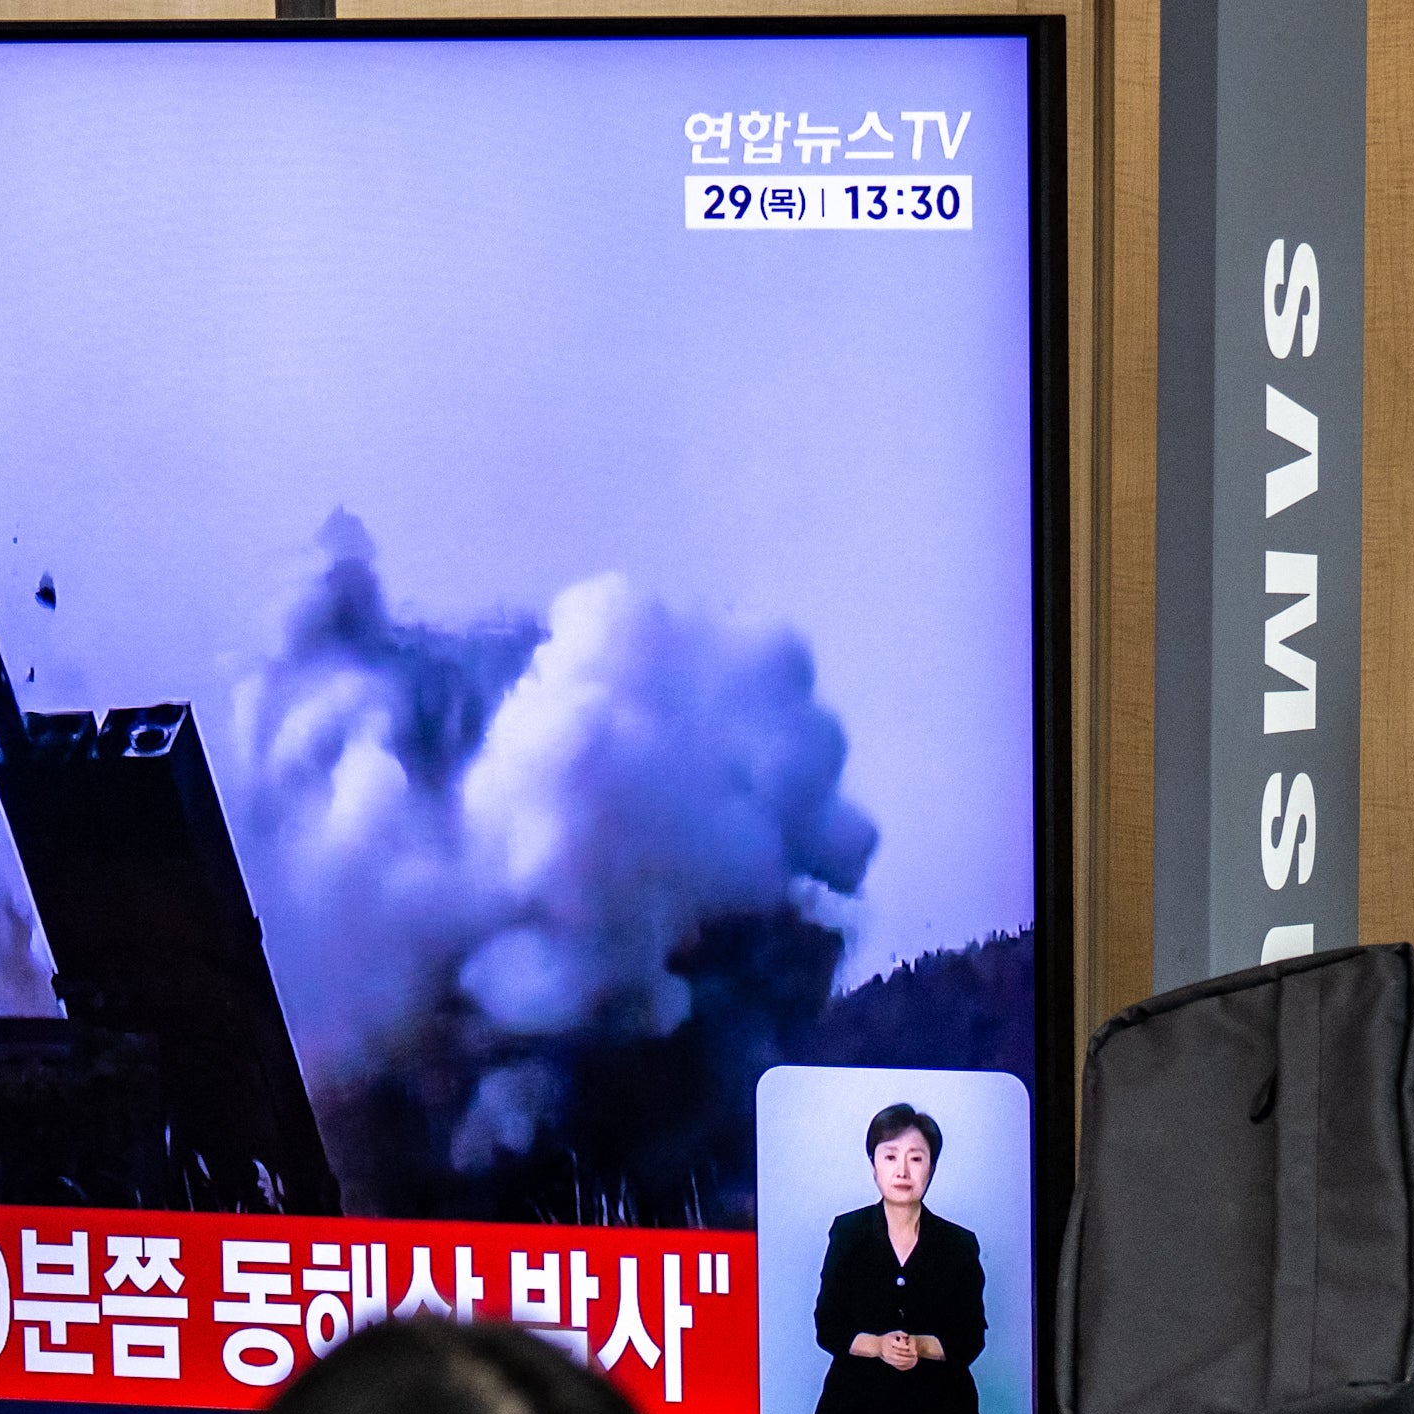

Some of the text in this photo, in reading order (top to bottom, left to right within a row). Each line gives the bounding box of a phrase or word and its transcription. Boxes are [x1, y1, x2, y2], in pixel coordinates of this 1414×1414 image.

[683, 110, 973, 165] 연합뉴스TV
[703, 183, 961, 221] 29(목) 13:30
